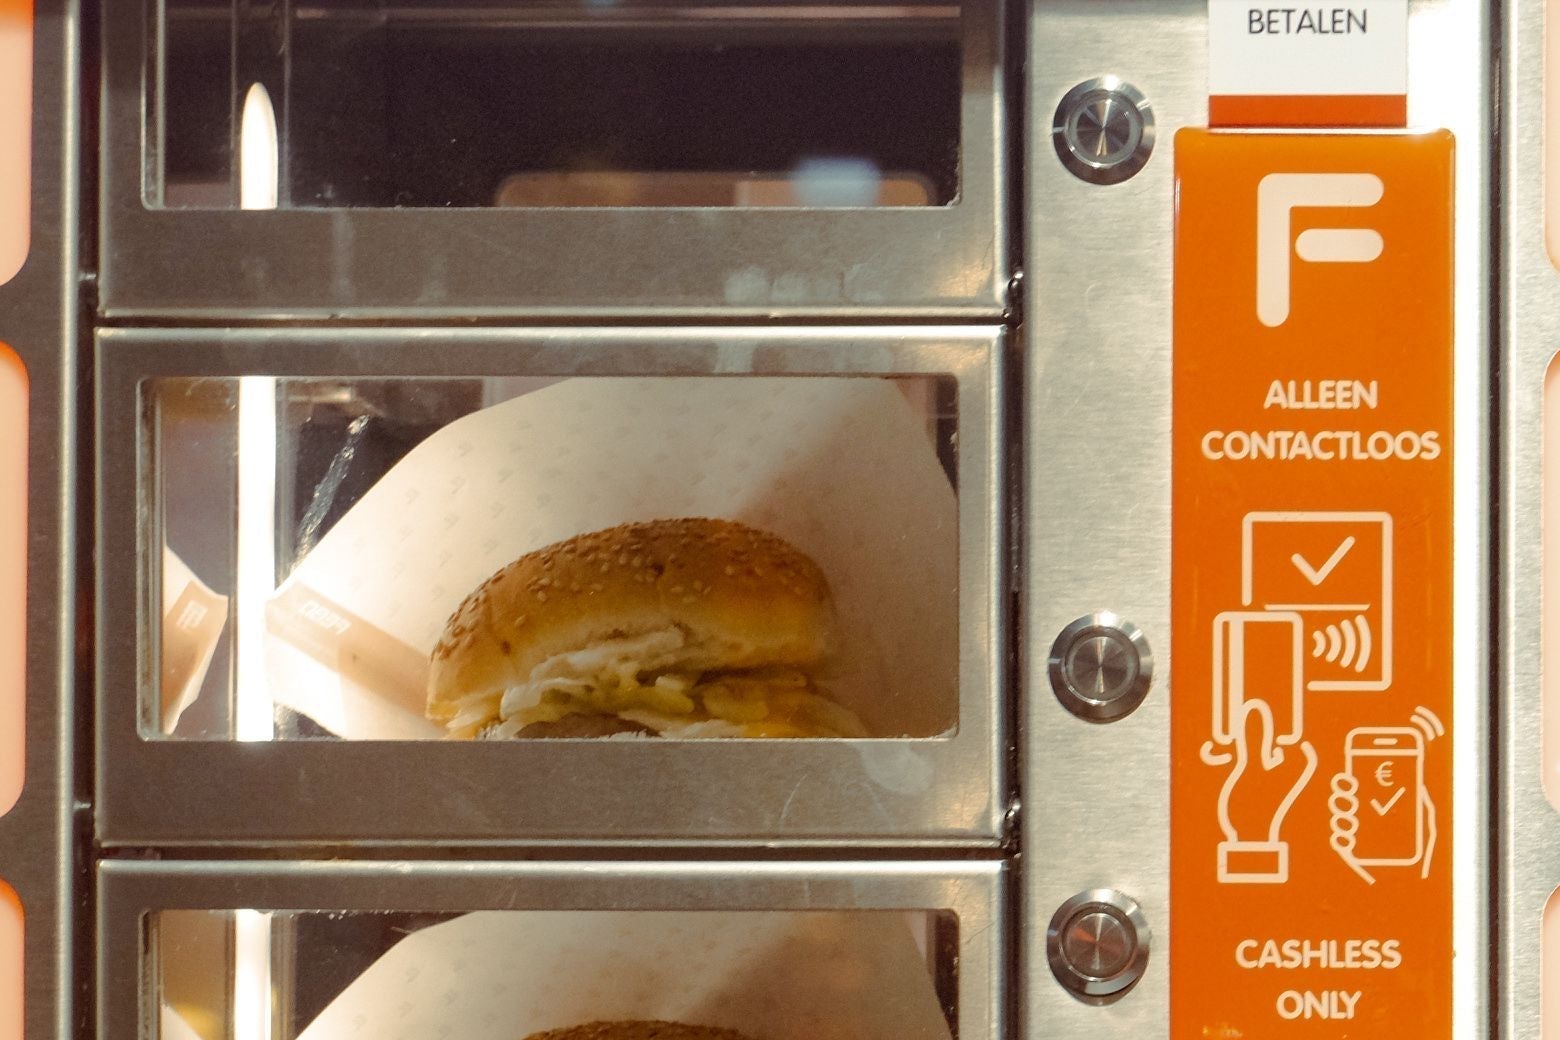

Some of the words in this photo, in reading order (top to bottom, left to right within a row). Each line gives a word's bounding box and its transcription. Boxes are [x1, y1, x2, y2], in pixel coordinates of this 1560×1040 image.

[1248, 8, 1367, 35] BETALEN
[1256, 173, 1384, 328] F
[1263, 379, 1379, 410] ALLEEN
[1201, 430, 1442, 461] CONTACTLOOS
[1235, 938, 1403, 970] CASHLESS
[1276, 990, 1362, 1020] ONLY
